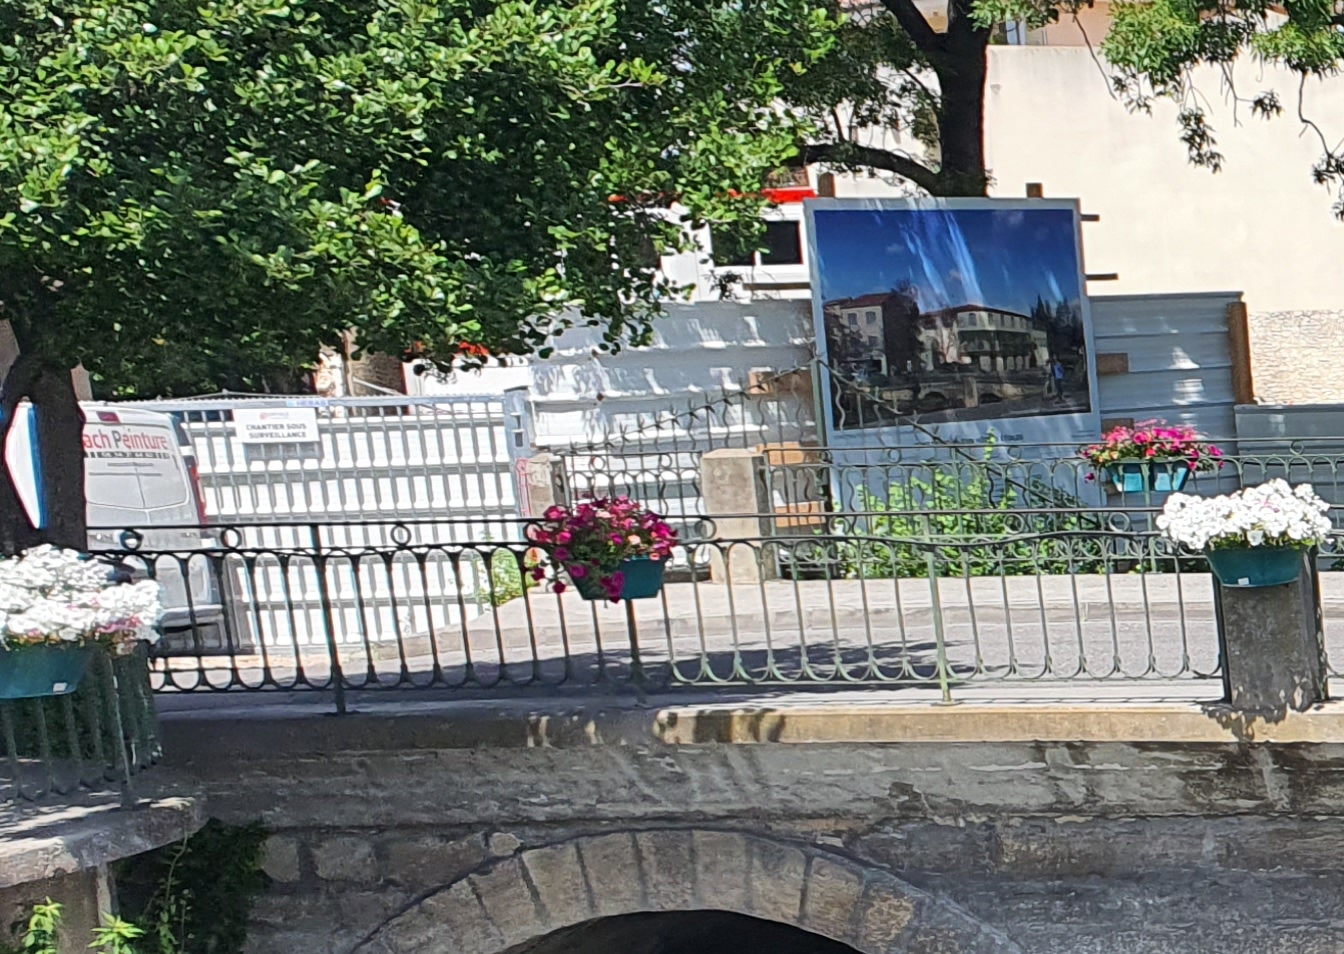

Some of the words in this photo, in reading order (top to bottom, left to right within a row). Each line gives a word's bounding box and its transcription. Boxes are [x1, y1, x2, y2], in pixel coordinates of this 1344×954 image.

[82, 429, 111, 449] ach
[112, 428, 168, 450] Peinture
[249, 431, 306, 439] SURVEILLANCE
